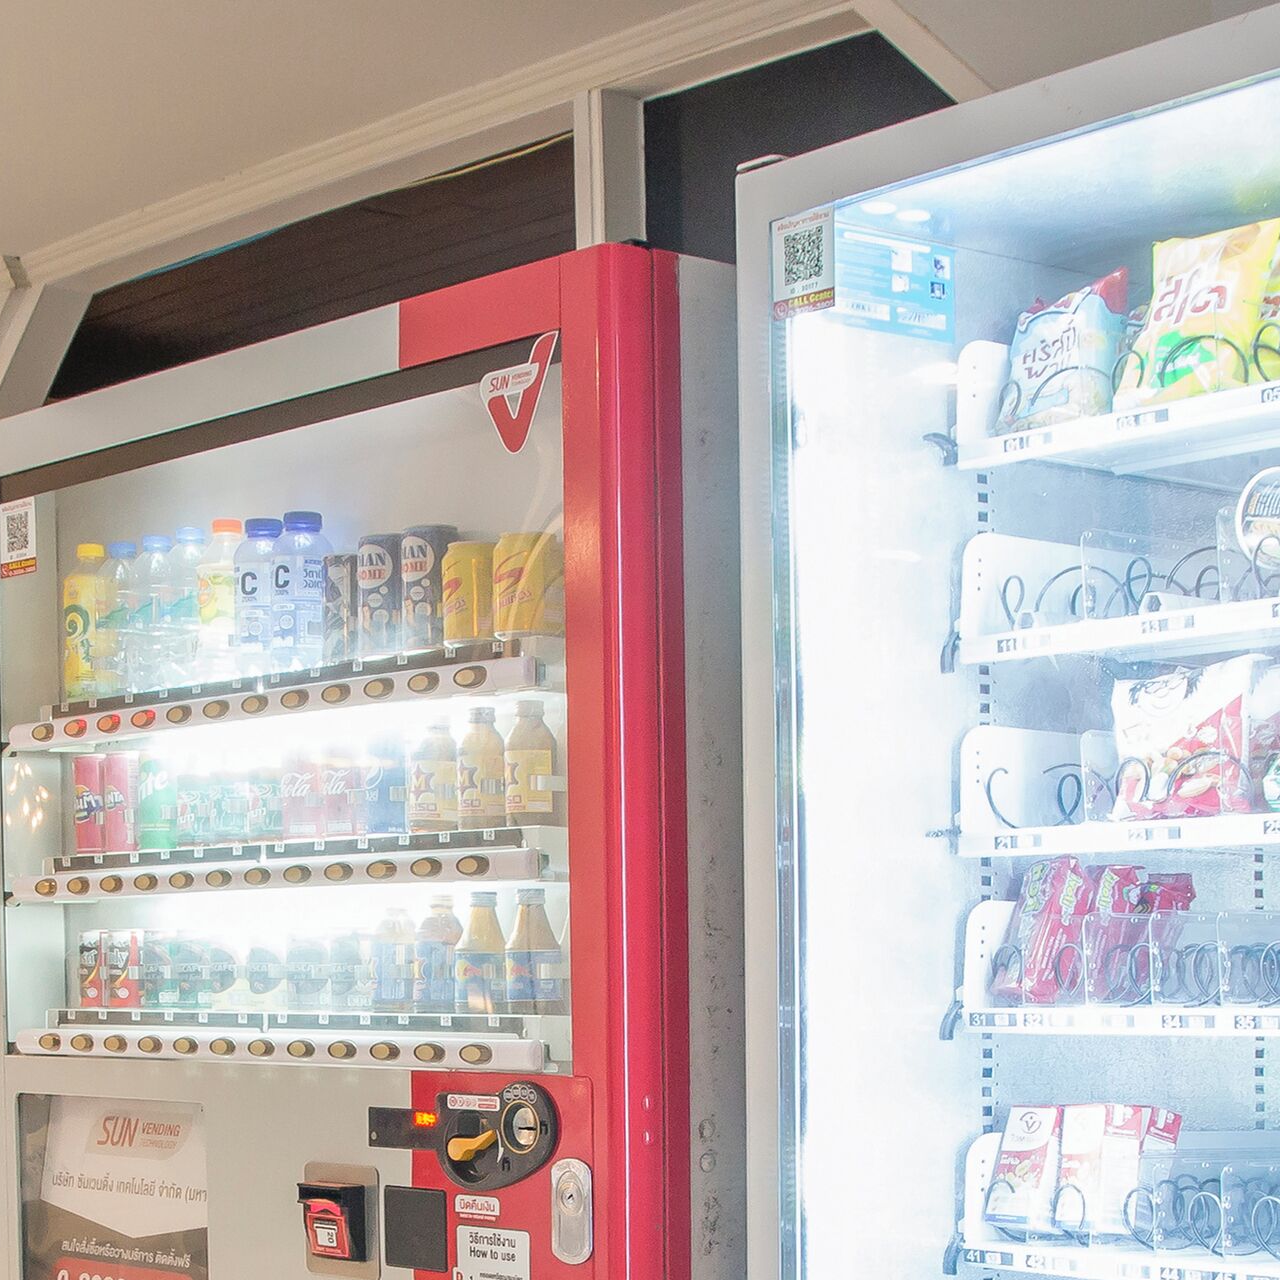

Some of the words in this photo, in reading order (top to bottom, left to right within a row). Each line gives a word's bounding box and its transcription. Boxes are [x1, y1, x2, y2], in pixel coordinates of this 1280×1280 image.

[489, 374, 510, 393] SUN
[240, 571, 258, 596] C
[274, 564, 290, 589] C
[971, 1014, 988, 1027] 31
[1163, 1016, 1181, 1030] 34
[1236, 1016, 1255, 1030] 35
[97, 1115, 140, 1148] SUN
[141, 1121, 181, 1137] VENDING
[52, 1170, 74, 1188] บริษัท
[116, 1177, 155, 1197] เทคโนโลยี
[159, 1180, 182, 1199] จำกัด
[469, 1231, 516, 1248] วิธีการใช้งาน
[469, 1246, 488, 1258] How
[490, 1249, 499, 1260] to
[501, 1251, 516, 1262] use
[966, 1250, 981, 1262] 41
